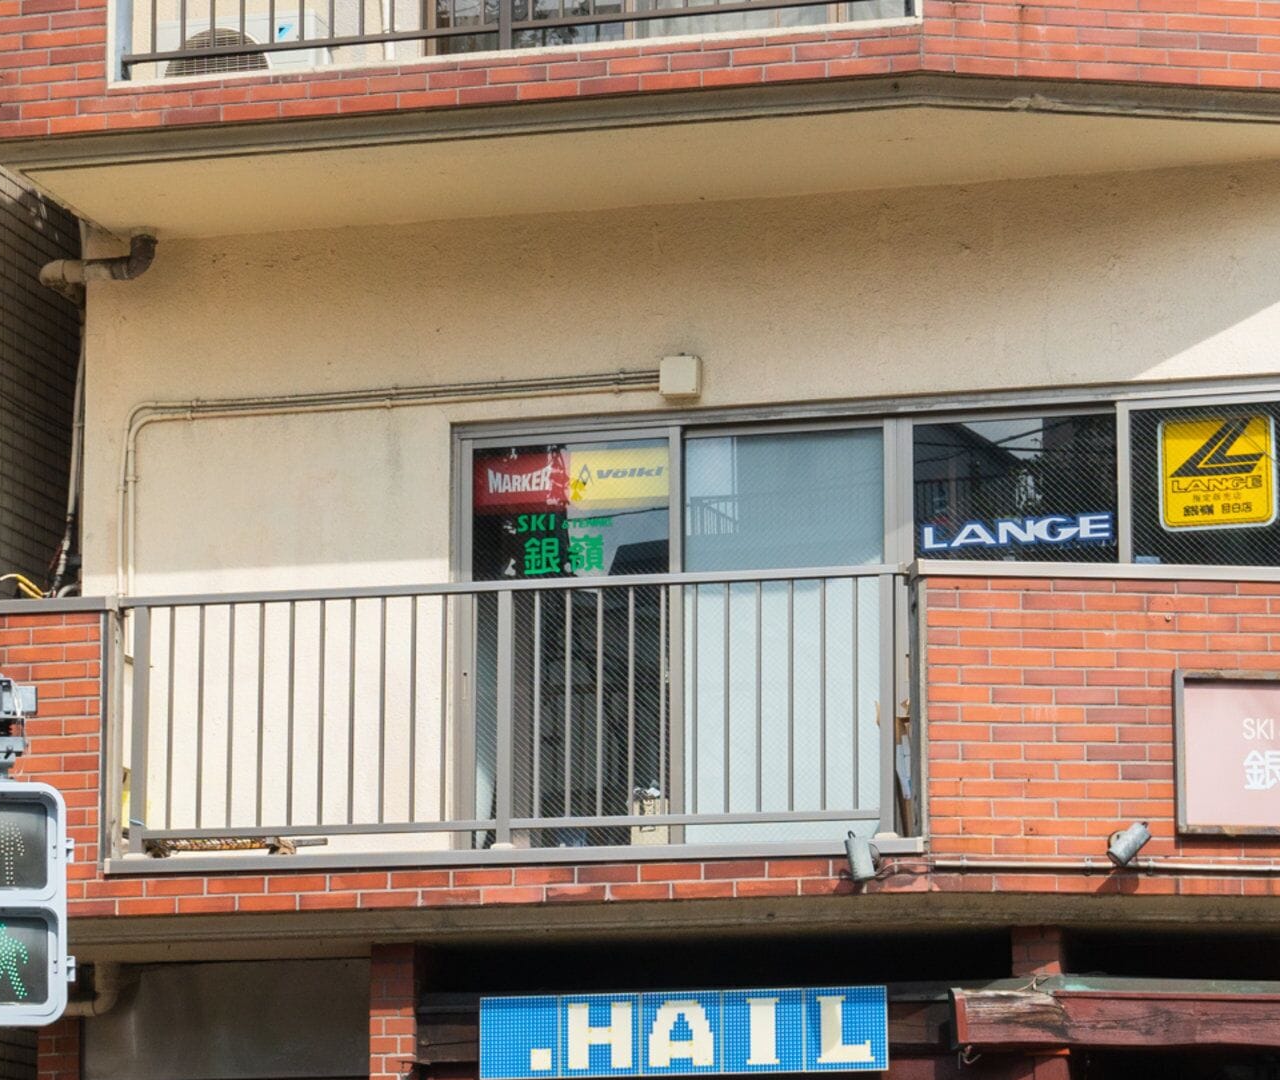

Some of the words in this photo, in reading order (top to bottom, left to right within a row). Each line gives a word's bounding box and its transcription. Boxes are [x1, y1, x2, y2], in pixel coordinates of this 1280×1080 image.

[487, 462, 553, 494] MARKER
[1172, 474, 1263, 493] LANGE
[517, 513, 556, 532] SKI
[923, 513, 1111, 550] LANGE
[523, 534, 606, 575] 銀嶺
[1242, 717, 1275, 741] SKI
[530, 996, 875, 1071] .HAIL
